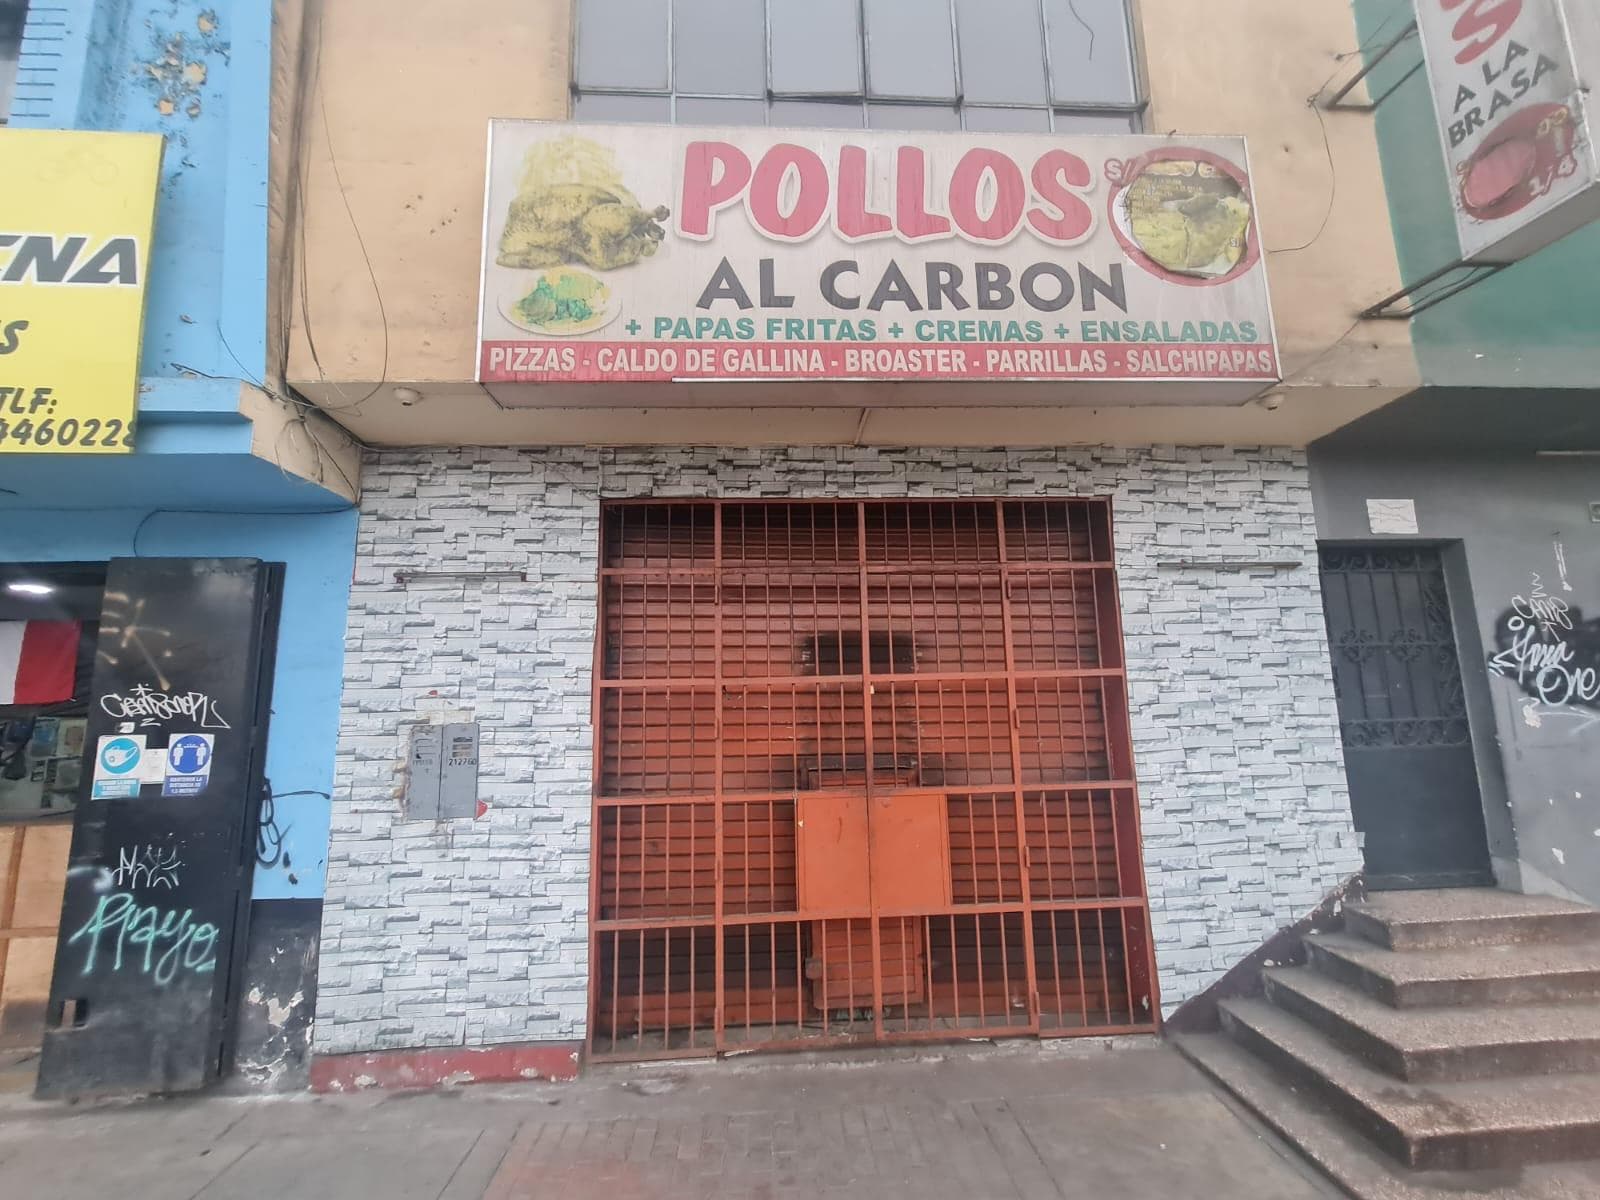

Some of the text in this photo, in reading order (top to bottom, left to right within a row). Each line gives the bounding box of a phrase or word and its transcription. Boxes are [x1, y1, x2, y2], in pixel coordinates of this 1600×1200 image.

[1448, 53, 1559, 148] BRASA
[1453, 39, 1529, 114] A LA
[679, 140, 1094, 243] POLLOS
[696, 255, 1128, 314] AL CARBON
[489, 346, 576, 372] PIZZAS
[598, 347, 678, 372] CALDO
[684, 348, 718, 372] DE
[722, 348, 826, 373] GALLINA
[844, 347, 968, 373] BROASTER
[985, 348, 1108, 373] PARRILLAS
[1126, 348, 1273, 374] SALCHIPAPAS
[653, 316, 755, 340] PAPAS
[765, 317, 877, 342] FRITAS
[915, 319, 1044, 343] CREMAS
[1080, 319, 1259, 343] ENSALADAS
